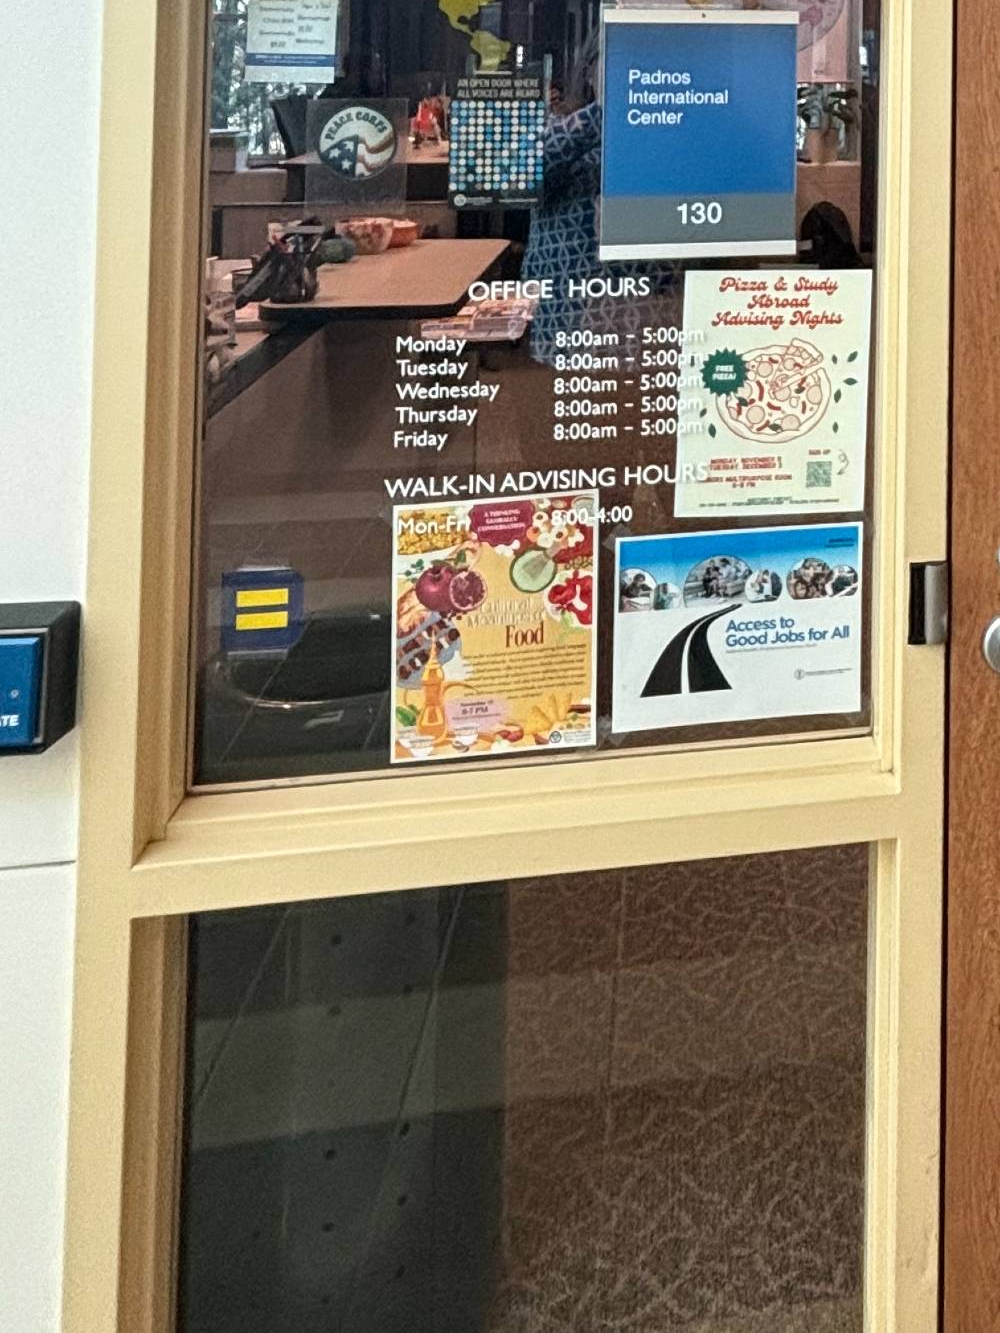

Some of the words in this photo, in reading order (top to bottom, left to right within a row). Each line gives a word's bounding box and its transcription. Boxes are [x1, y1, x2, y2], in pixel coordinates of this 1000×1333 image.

[628, 69, 691, 85] Padnos
[628, 89, 728, 105] International
[325, 113, 352, 141] PEACE
[355, 112, 389, 135] CORPS
[627, 109, 683, 126] Center
[677, 202, 723, 225] 130
[468, 279, 553, 302] OFFICE
[569, 277, 650, 299] HOURS
[719, 277, 768, 293] Pizza
[774, 276, 788, 292] &
[794, 276, 839, 295] Study
[747, 294, 811, 309] Abroad
[711, 311, 785, 330] Advising
[790, 310, 843, 330] Nights
[396, 336, 467, 357] Monday
[555, 331, 619, 348] 8:00am
[642, 326, 705, 348] 5:00pm
[396, 359, 468, 379] Tuesday
[555, 354, 618, 371] 8:00am
[641, 349, 705, 371] 5:00pm
[396, 383, 500, 402] Wednesday
[553, 377, 617, 394] 8:00am
[639, 373, 703, 394] 5:00pm
[395, 406, 478, 426] Thursday
[553, 400, 617, 417] 8:00am
[640, 395, 703, 417] 5:00pm
[393, 430, 449, 451] Friday
[553, 423, 617, 441] 8:00am
[640, 418, 702, 439] 5:00pm
[384, 473, 495, 499] WALK-IN
[500, 468, 616, 493] ADVISING
[624, 465, 708, 486] HOURS
[505, 621, 544, 648] Food
[726, 618, 776, 632] Access
[780, 617, 795, 629] to
[726, 633, 768, 647] Good
[771, 630, 805, 644] Jobs
[808, 627, 828, 640] for
[831, 625, 850, 638] All
